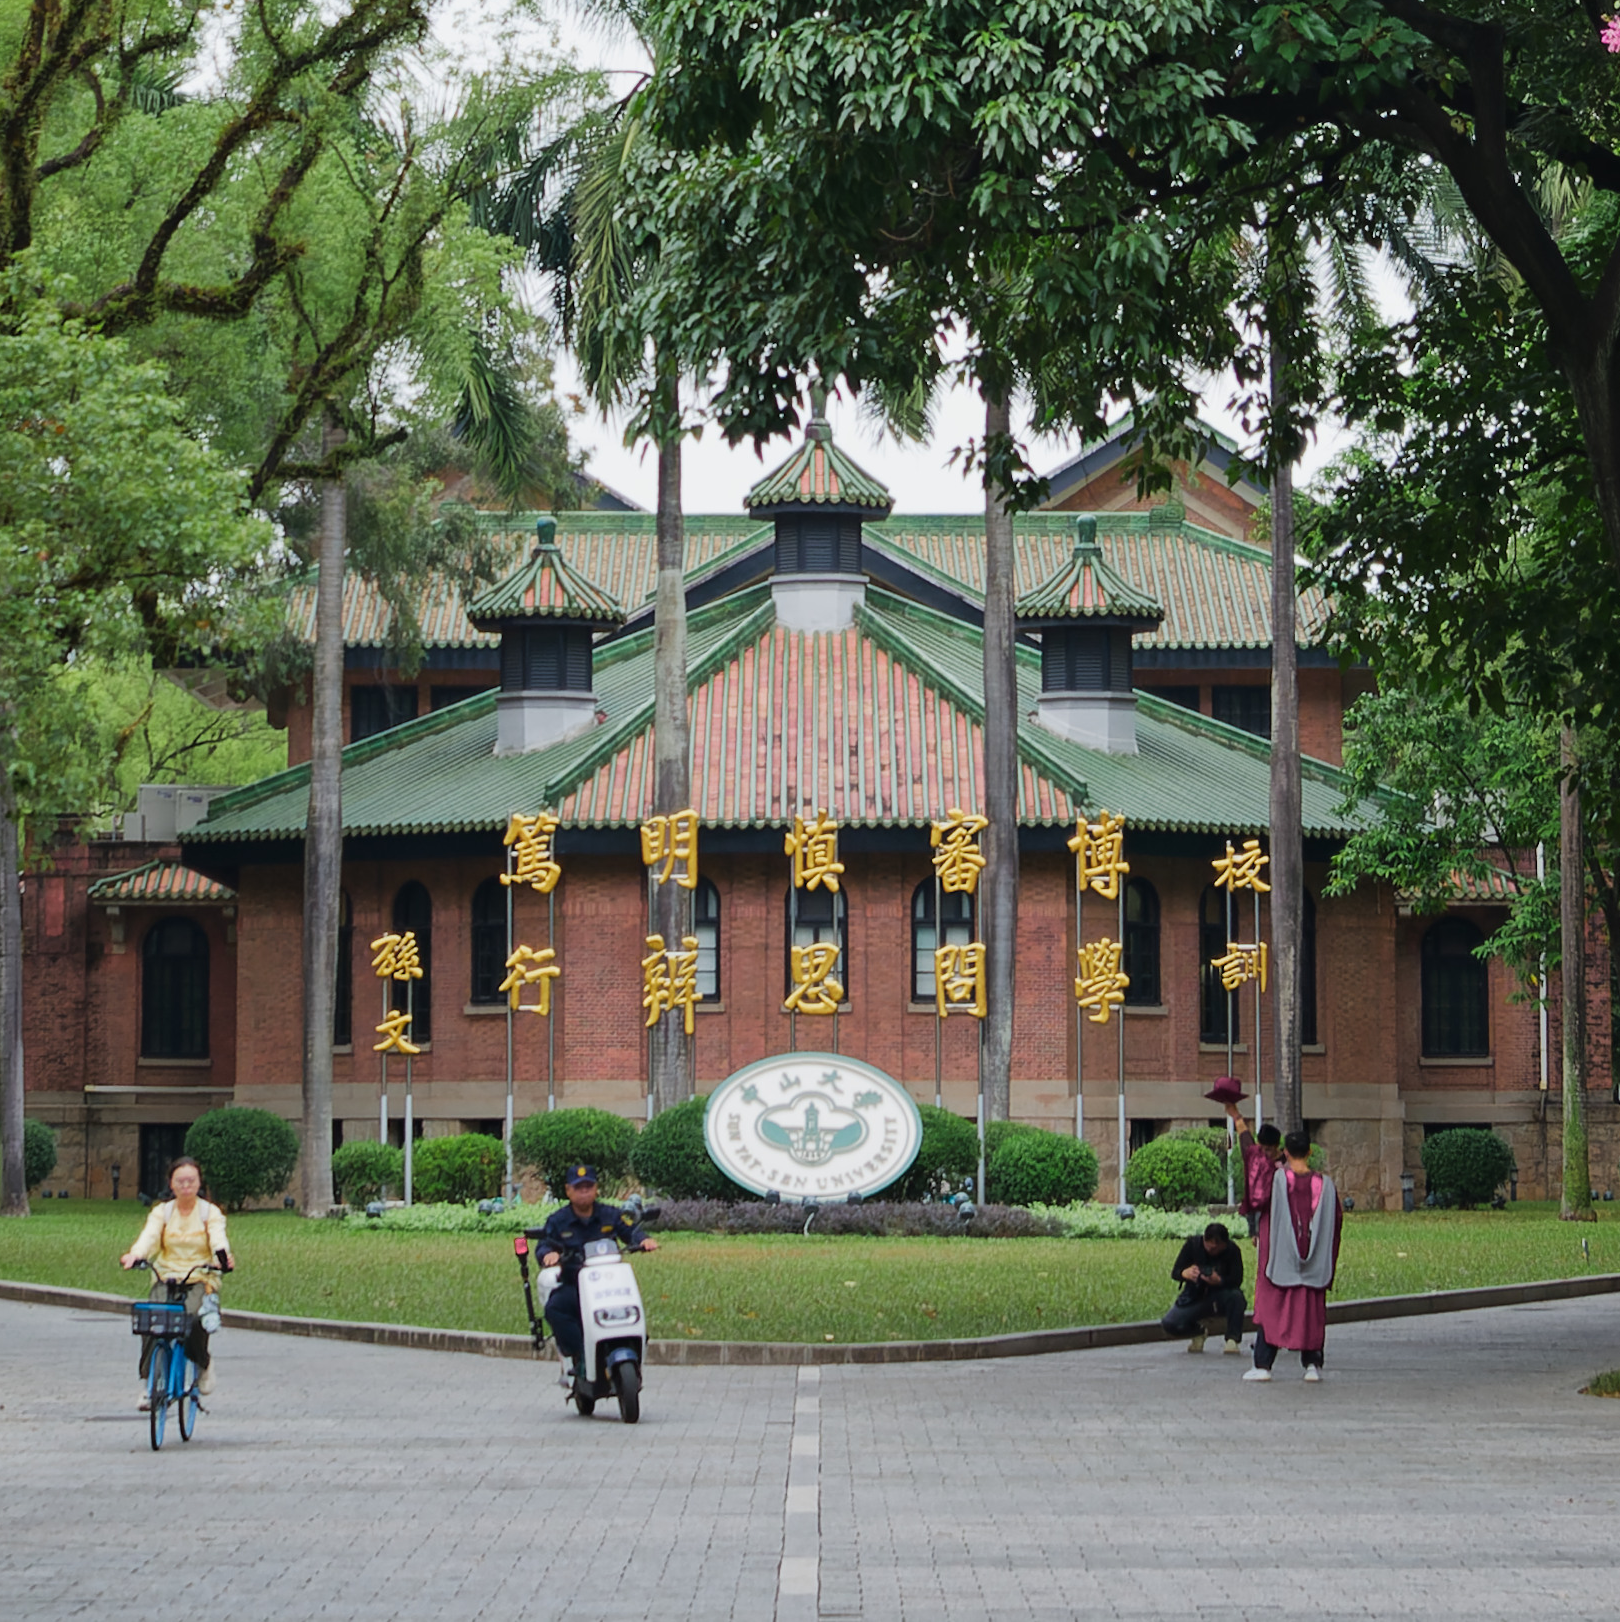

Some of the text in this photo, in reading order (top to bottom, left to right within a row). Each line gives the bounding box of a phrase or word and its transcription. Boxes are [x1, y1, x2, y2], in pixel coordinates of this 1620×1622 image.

[370, 931, 423, 1054] 孫文
[498, 812, 561, 1016] 篤行
[784, 808, 845, 1015] 慎思
[930, 808, 989, 1018] 審問
[1067, 809, 1130, 1023] 博學
[1211, 840, 1271, 993] 校訓
[727, 1113, 742, 1142] SUN
[817, 1116, 897, 1190] UNIVERSITY
